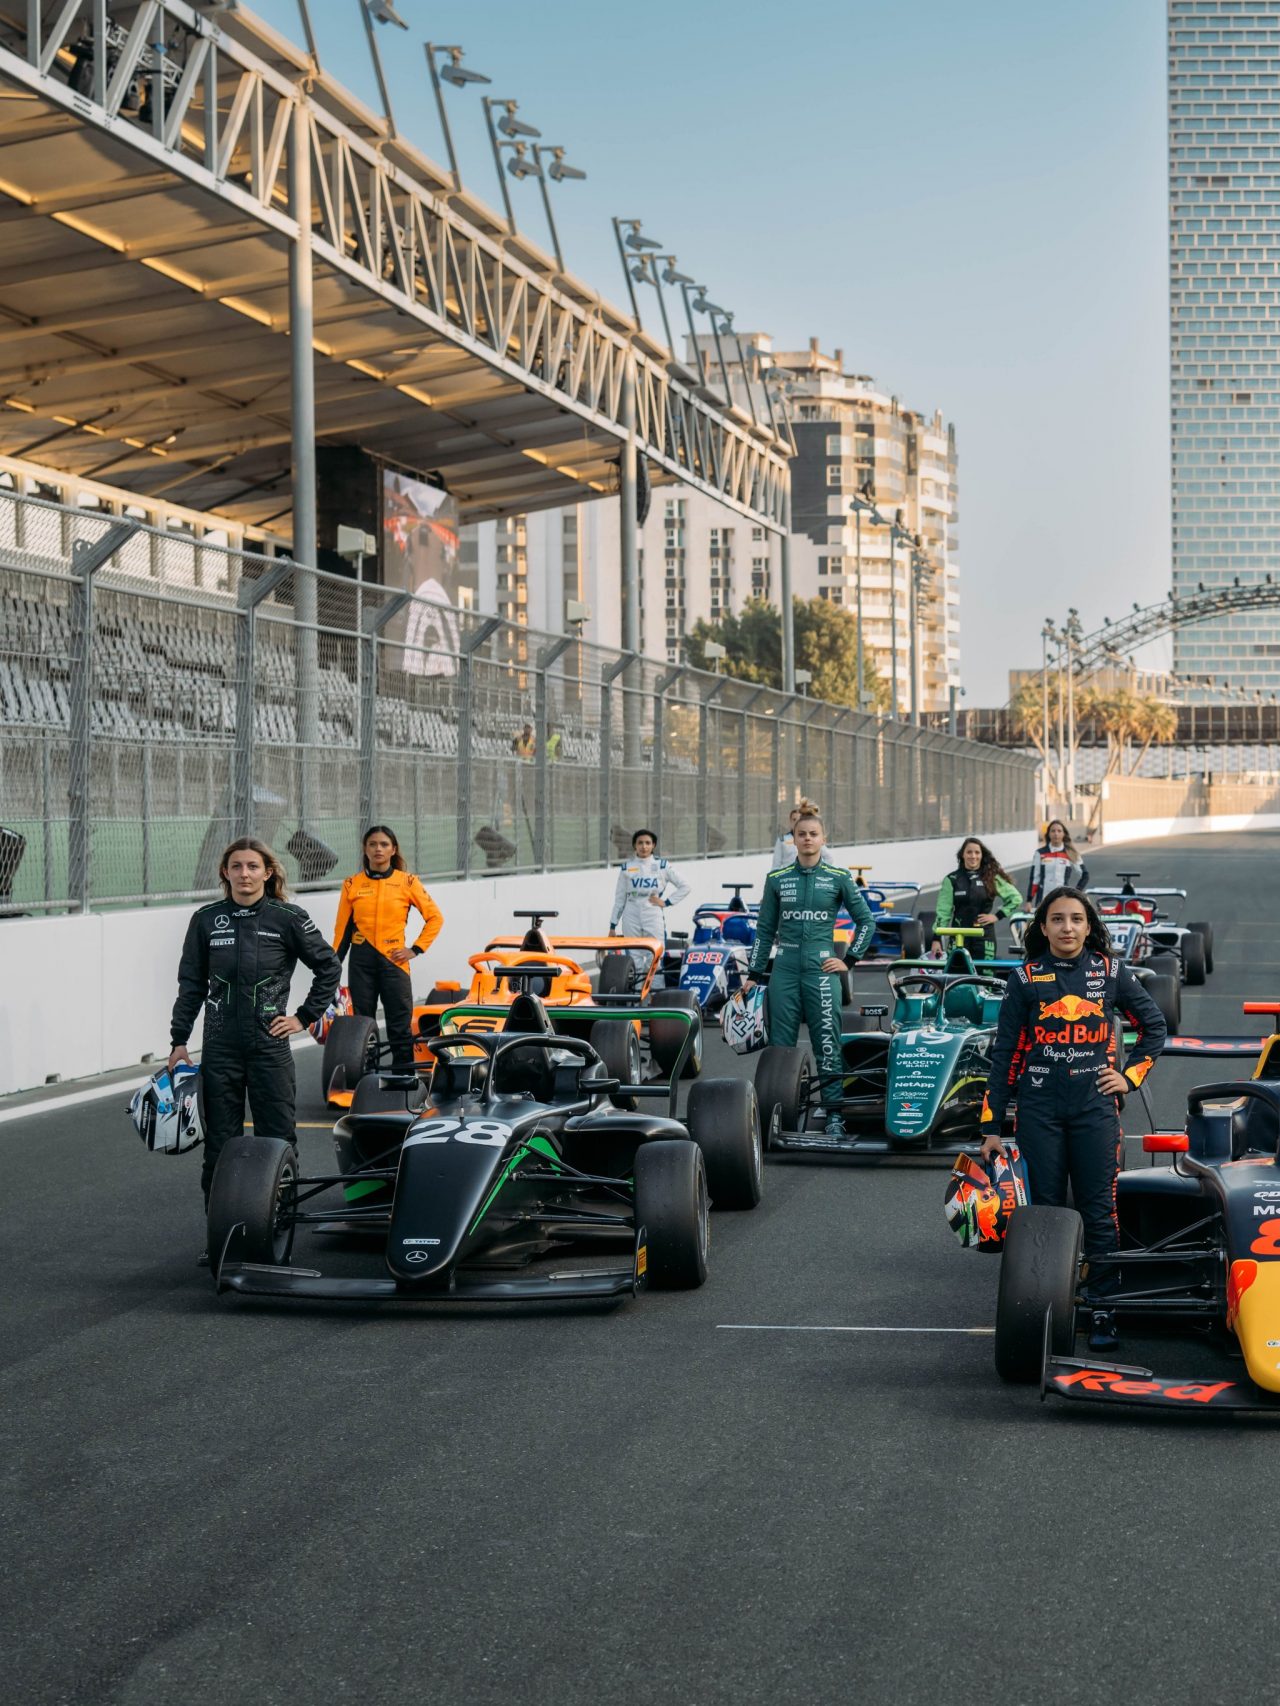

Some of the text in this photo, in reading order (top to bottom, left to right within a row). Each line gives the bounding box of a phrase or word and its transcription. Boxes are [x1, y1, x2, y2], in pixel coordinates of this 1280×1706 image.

[631, 877, 659, 889] VISA
[782, 910, 829, 921] aramco
[686, 951, 724, 965] 88
[1085, 970, 1105, 978] Mobil
[864, 1008, 883, 1016] BOSS
[819, 976, 834, 1072] MARTIN ASTON
[905, 1030, 954, 1045] 19
[1033, 1022, 1108, 1045] Red Bull
[1171, 1037, 1269, 1050] Red
[896, 1051, 945, 1059] NexGen
[1043, 1045, 1067, 1062] Pepe
[1066, 1047, 1095, 1063] Jeans
[402, 1120, 513, 1150] 28
[1053, 1369, 1238, 1404] Red
